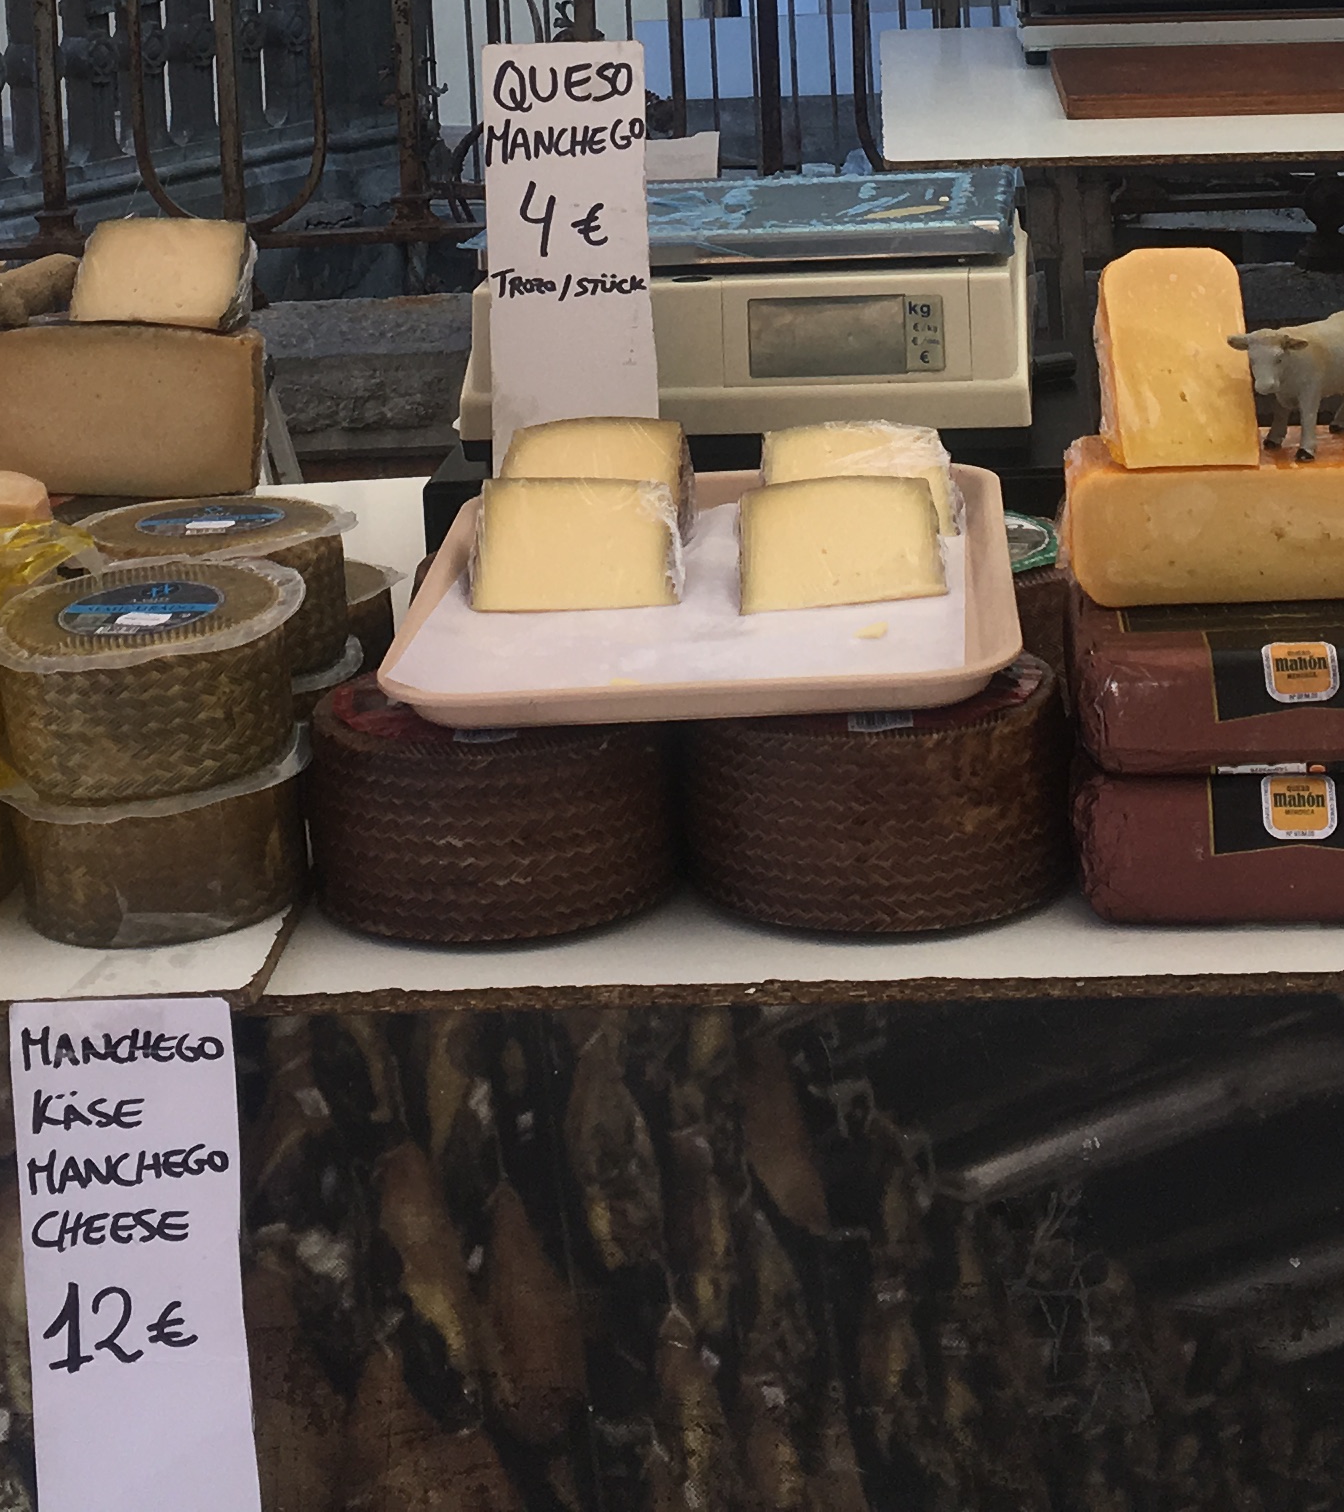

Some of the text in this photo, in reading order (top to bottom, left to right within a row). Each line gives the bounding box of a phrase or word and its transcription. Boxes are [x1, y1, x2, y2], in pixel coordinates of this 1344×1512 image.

[493, 60, 633, 113] QUESO
[485, 117, 645, 167] MANCHEGO
[520, 181, 608, 257] 4 €
[908, 301, 931, 317] kg
[21, 1026, 224, 1071] MANCHEGO
[33, 1089, 145, 1134] KÄSE
[27, 1144, 229, 1195] MANCHEGO
[32, 1209, 189, 1252] CHEESE
[43, 1282, 144, 1373] 12
